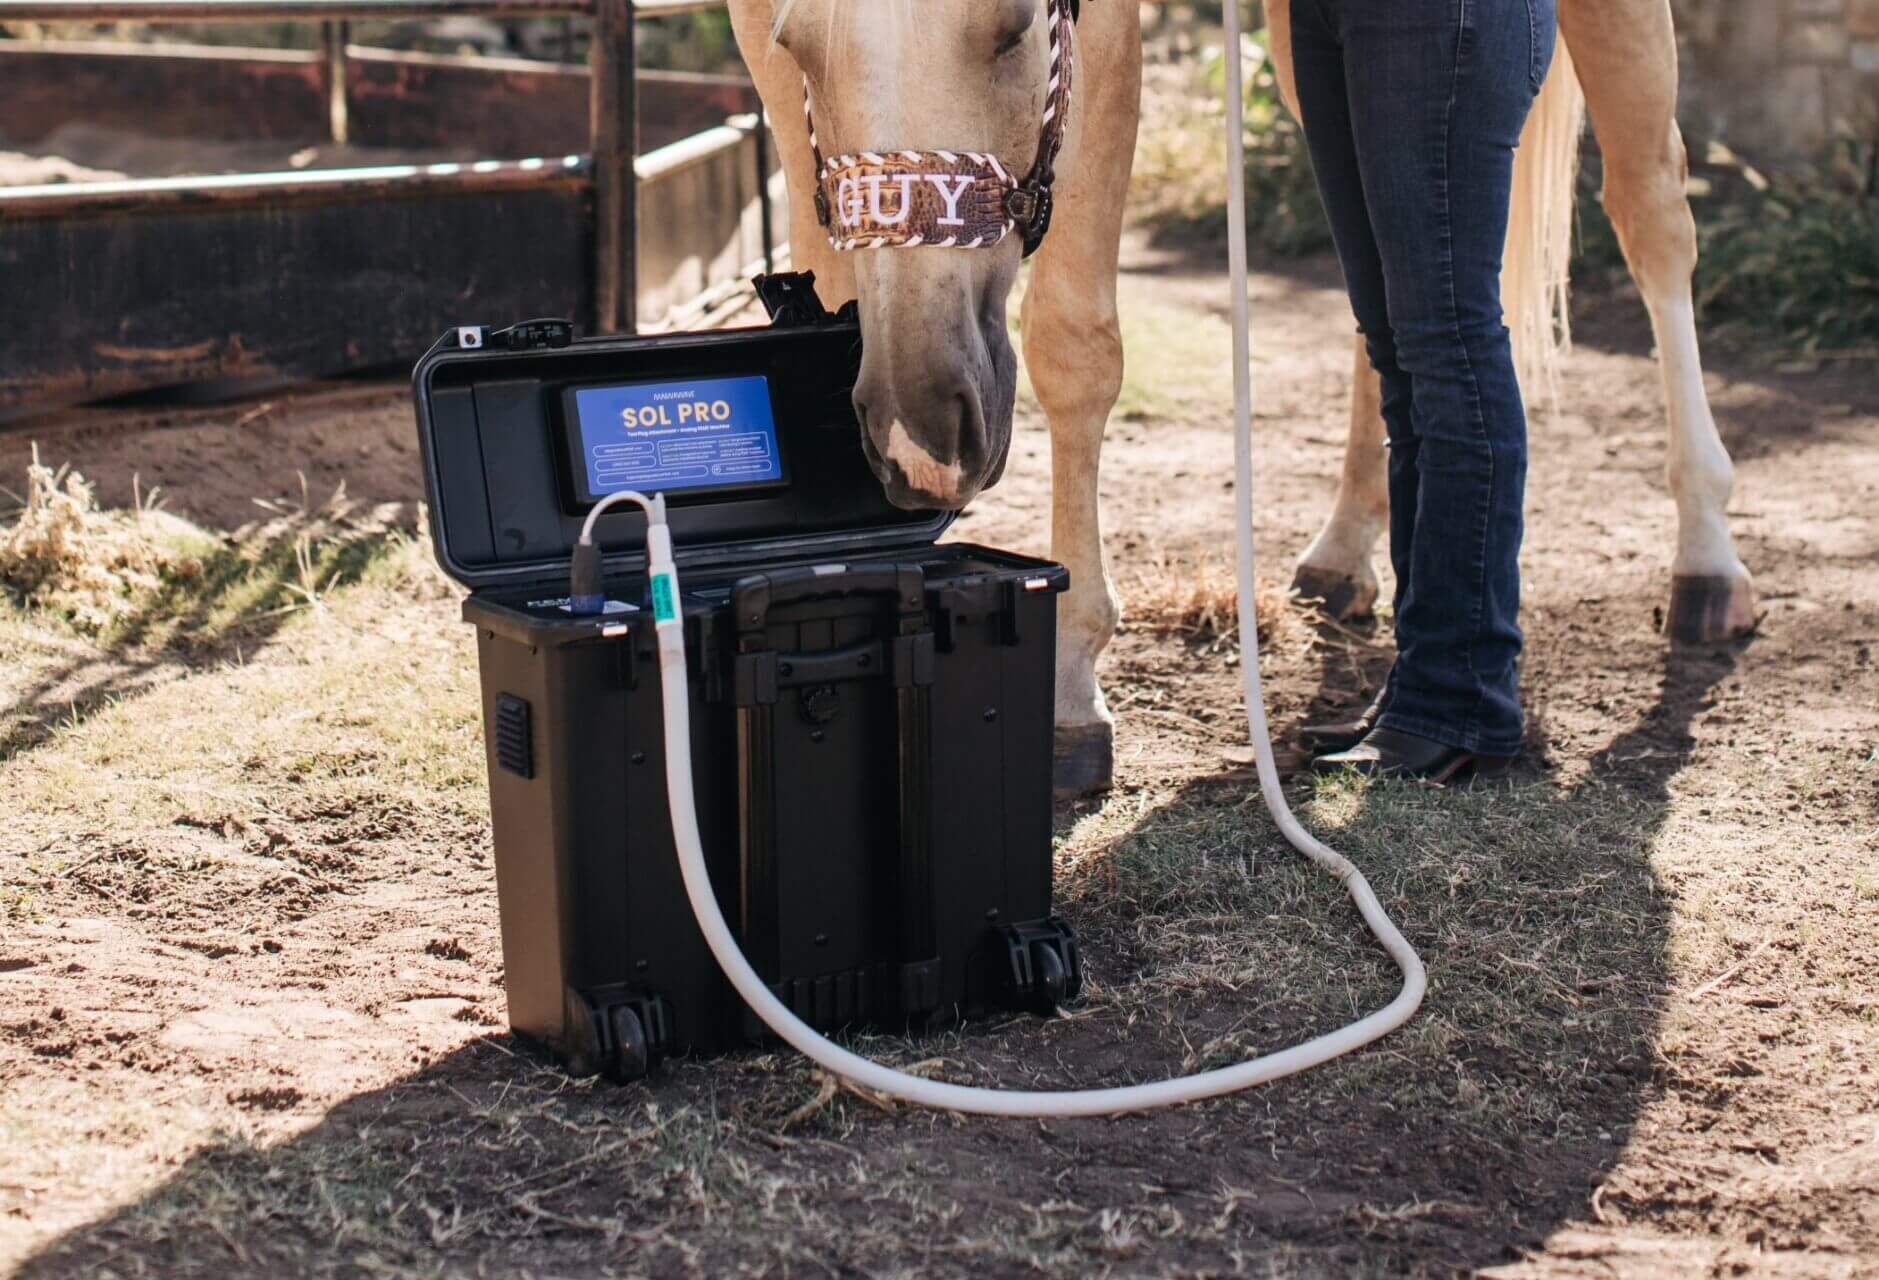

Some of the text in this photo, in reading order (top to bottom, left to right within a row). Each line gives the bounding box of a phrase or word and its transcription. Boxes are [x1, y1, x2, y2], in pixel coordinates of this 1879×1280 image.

[838, 173, 976, 226] GUY
[622, 400, 730, 428] SOL PRO
